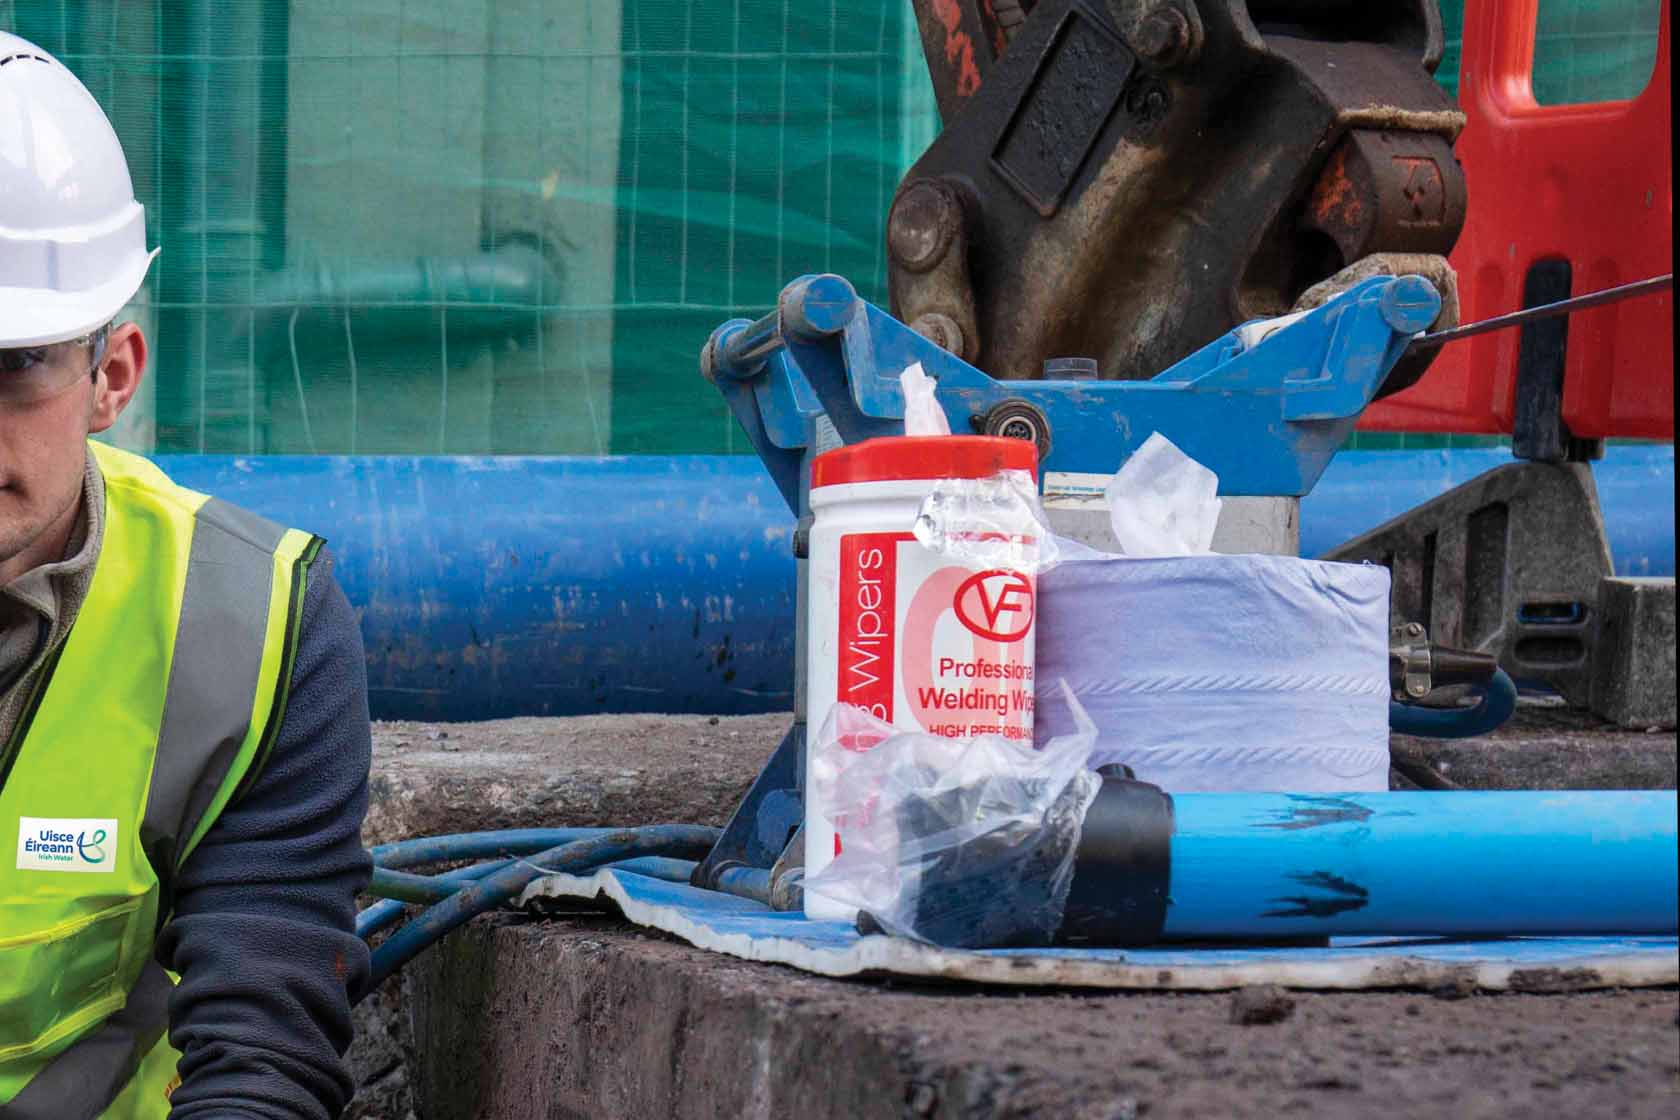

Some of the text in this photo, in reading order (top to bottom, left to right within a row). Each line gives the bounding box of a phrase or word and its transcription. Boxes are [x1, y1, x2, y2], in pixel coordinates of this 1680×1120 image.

[848, 548, 888, 692] Wipers
[918, 687, 1008, 716] Welding
[929, 724, 966, 738] HIGH
[40, 830, 74, 842] Uisce
[25, 838, 74, 853] Éireann
